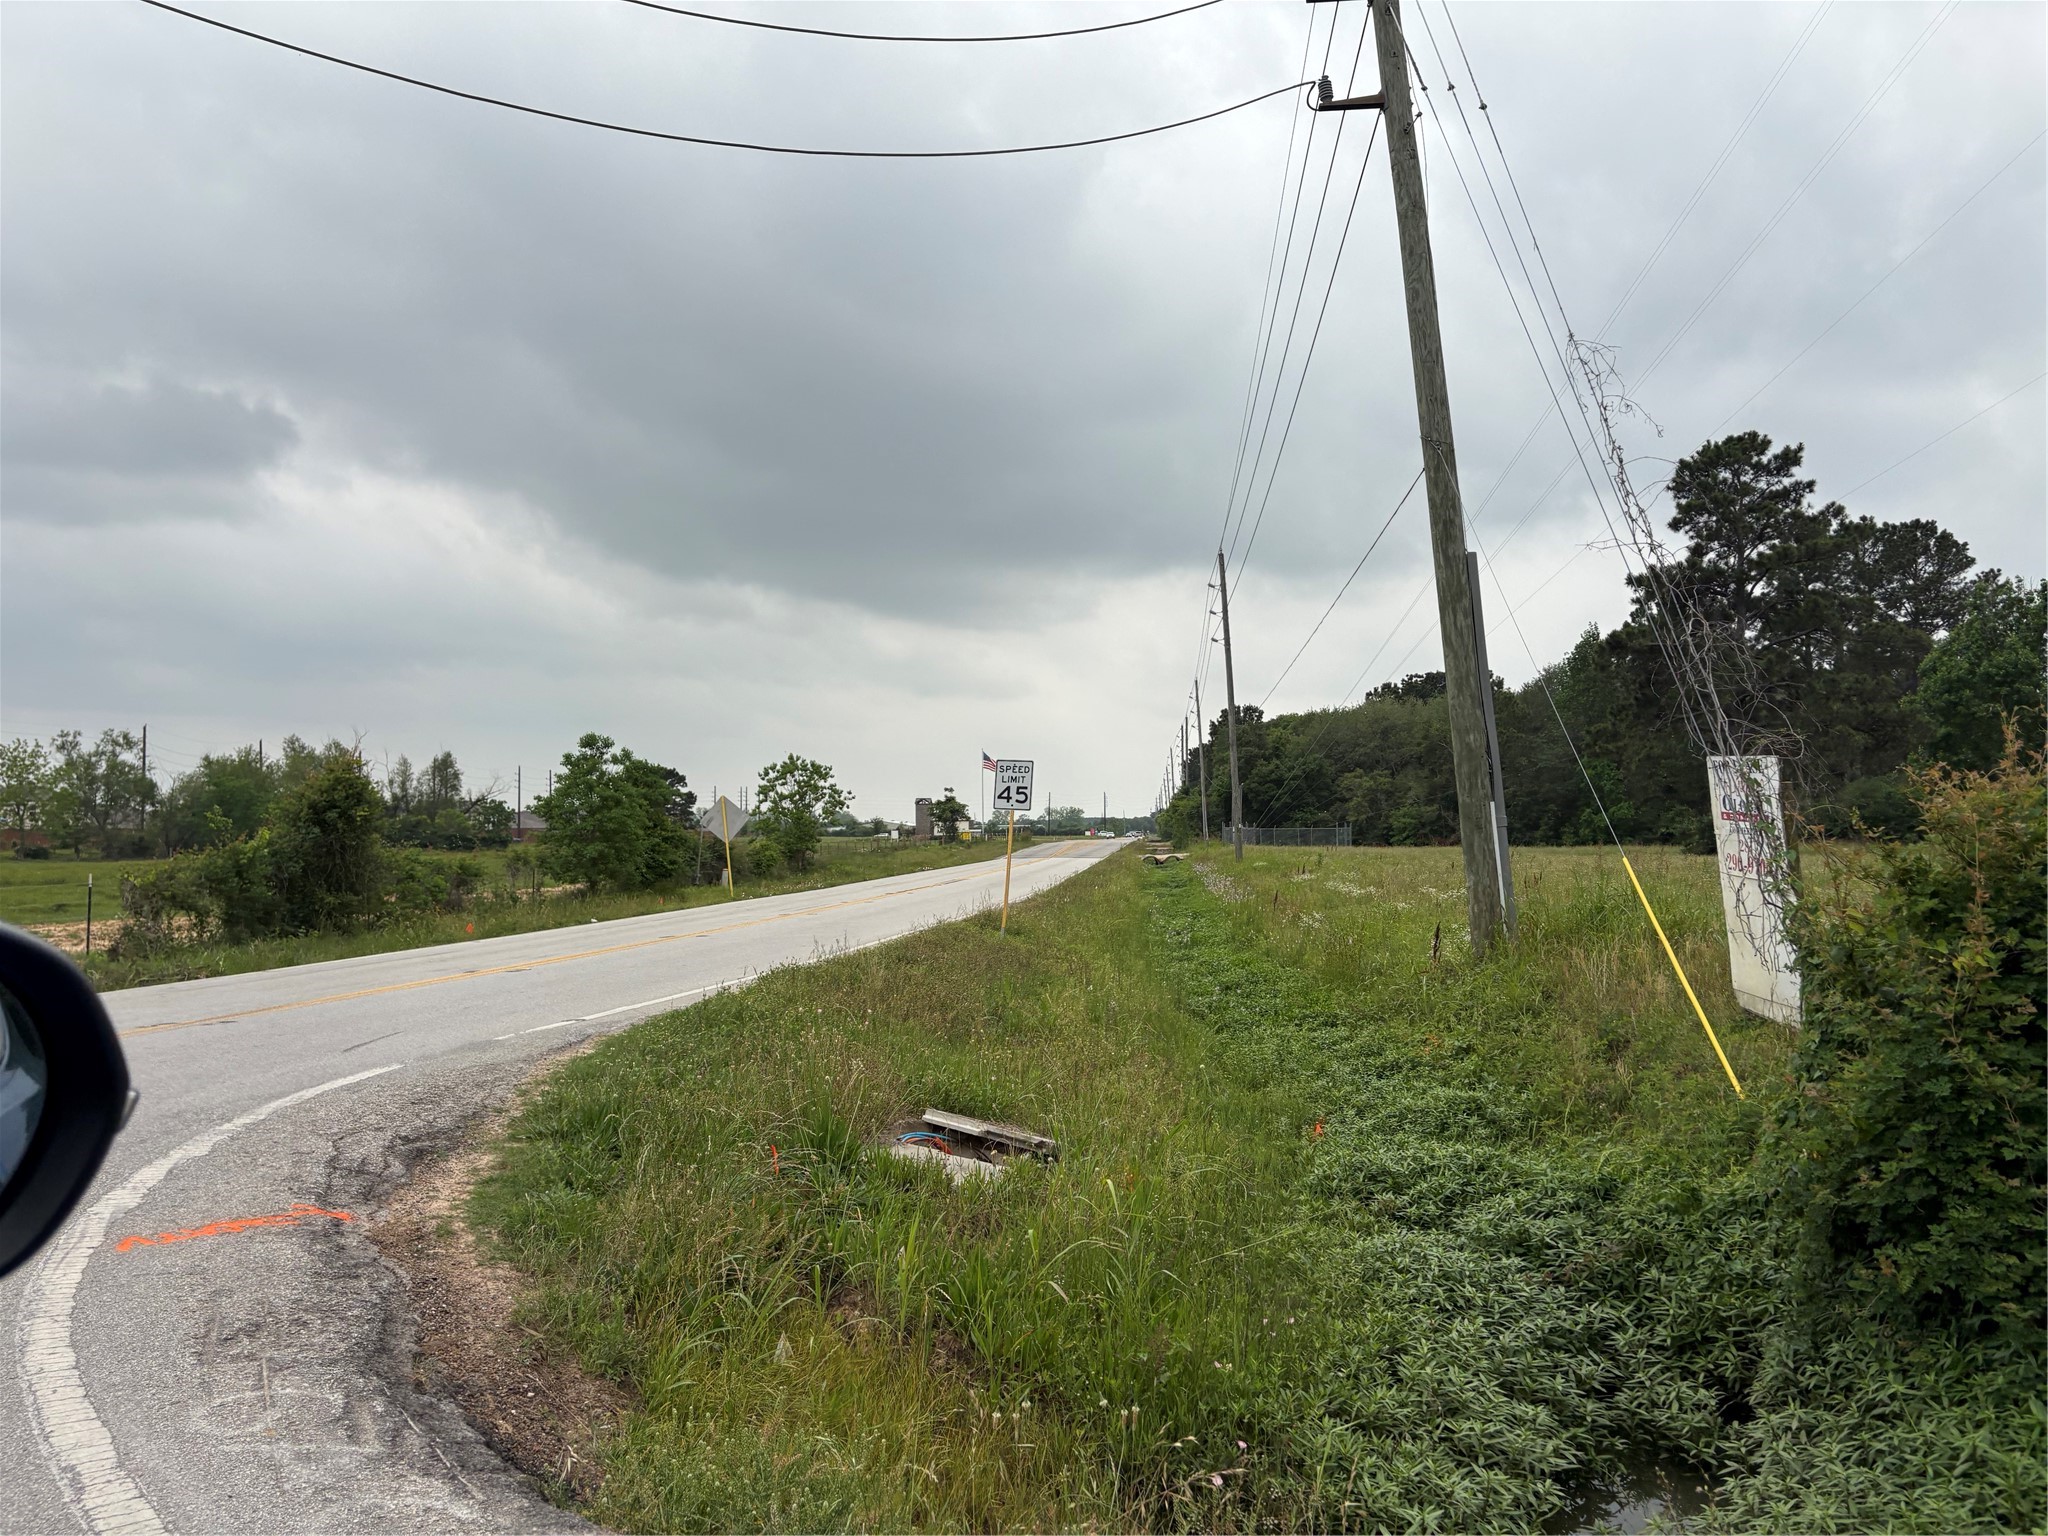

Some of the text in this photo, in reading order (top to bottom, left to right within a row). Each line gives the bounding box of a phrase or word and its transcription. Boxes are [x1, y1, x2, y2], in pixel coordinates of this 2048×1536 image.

[999, 765, 1030, 774] SPEED
[1001, 775, 1026, 783] LIMIT
[997, 785, 1028, 804] 45
